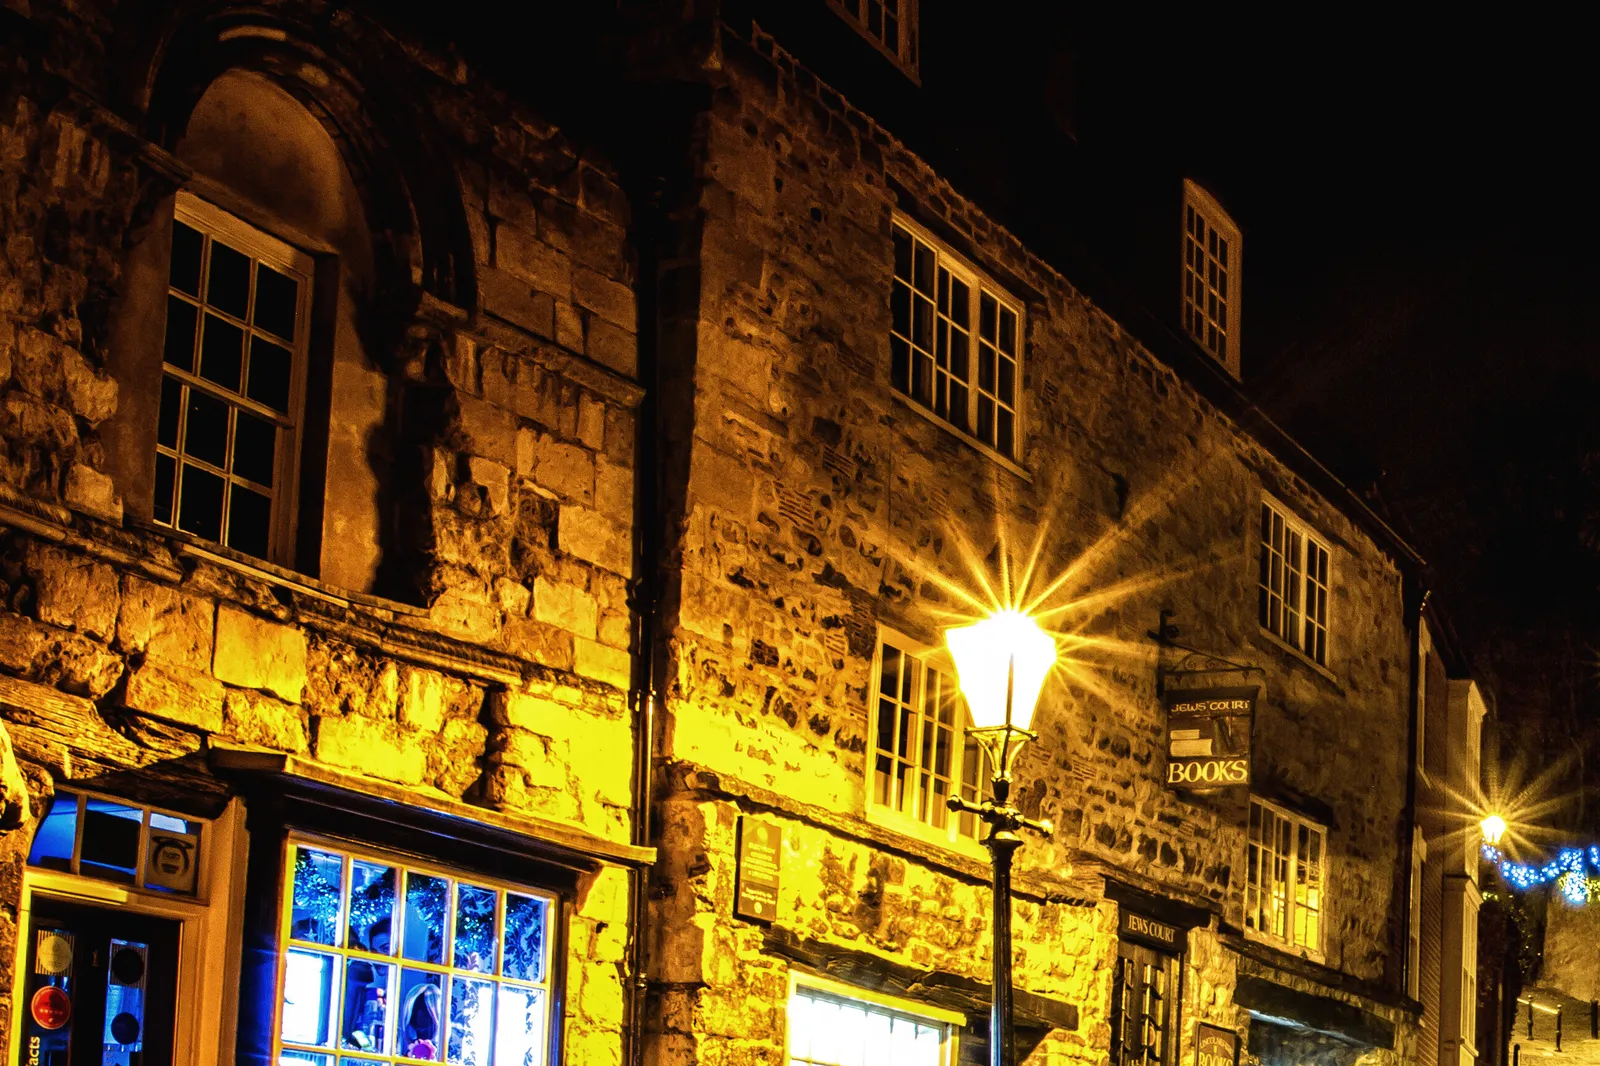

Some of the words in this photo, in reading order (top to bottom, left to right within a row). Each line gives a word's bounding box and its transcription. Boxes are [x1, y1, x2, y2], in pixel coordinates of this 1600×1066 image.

[1210, 700, 1251, 711] COURT
[1167, 760, 1249, 784] BOOKS
[1128, 914, 1148, 935] JEWS
[1149, 922, 1176, 943] COURT
